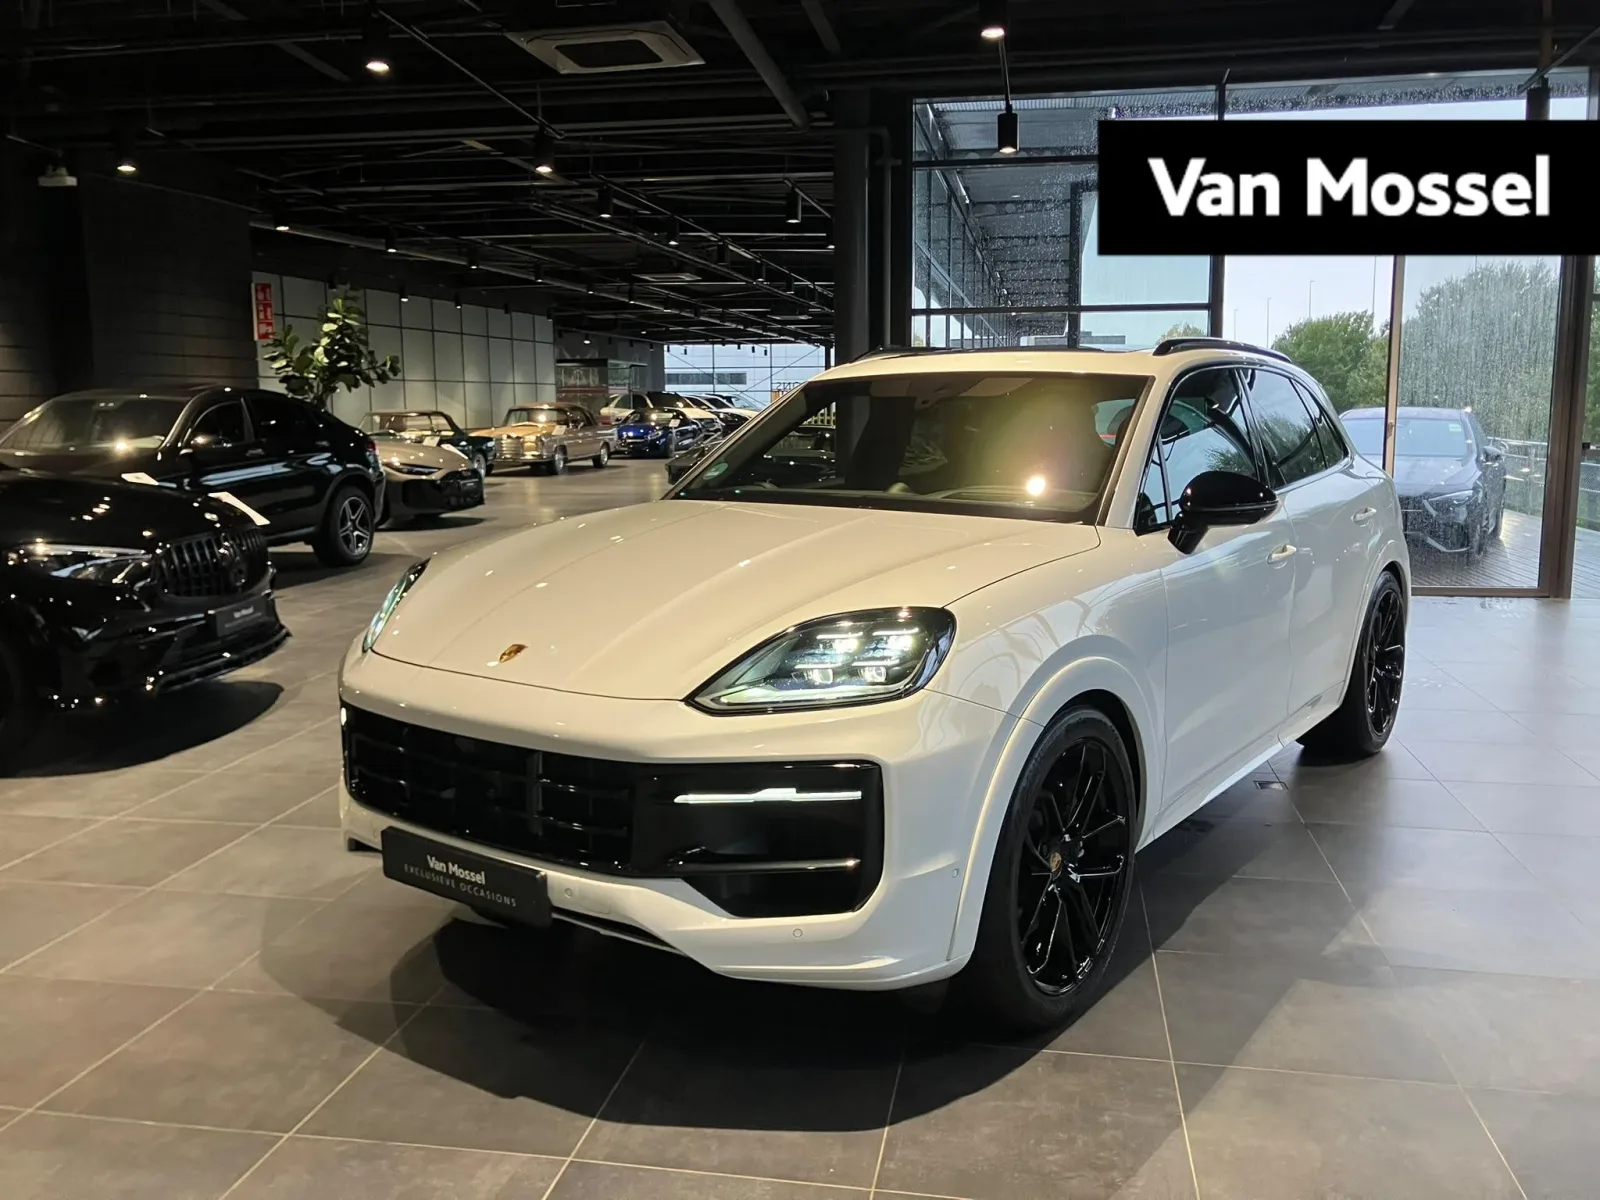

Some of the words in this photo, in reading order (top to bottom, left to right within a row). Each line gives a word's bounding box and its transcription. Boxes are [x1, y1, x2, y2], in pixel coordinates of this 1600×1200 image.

[404, 863, 456, 889] EXCLUSIEVE
[459, 882, 517, 908] OCCASIONS
[427, 855, 447, 872] Van
[448, 862, 486, 885] Mossel
